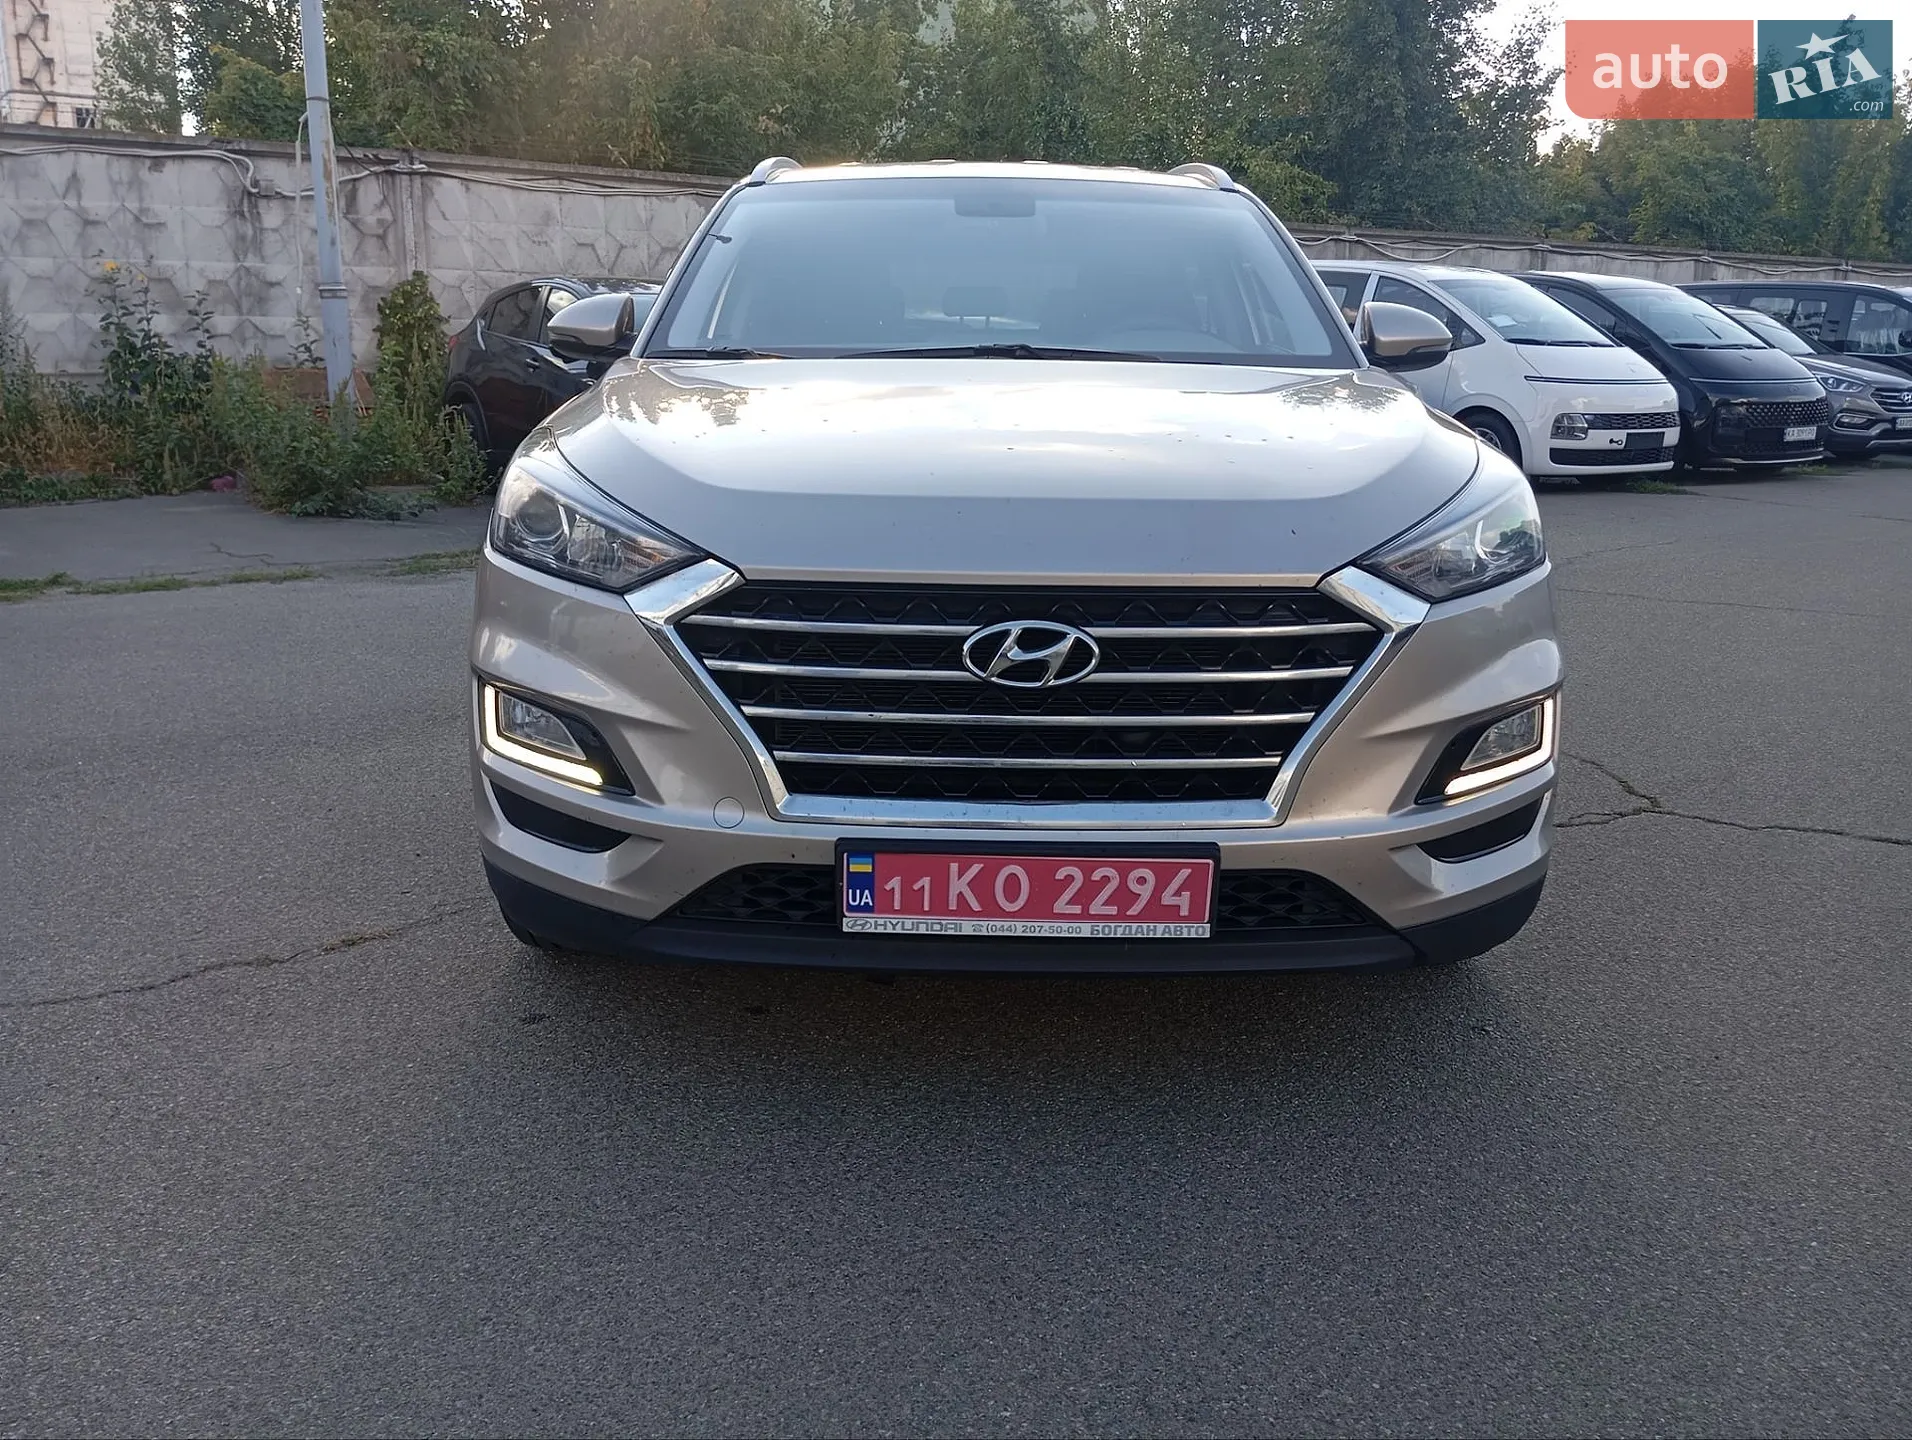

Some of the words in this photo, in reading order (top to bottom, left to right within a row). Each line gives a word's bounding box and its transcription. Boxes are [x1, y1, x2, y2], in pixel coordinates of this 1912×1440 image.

[848, 889, 873, 906] UA
[884, 876, 931, 911] 11
[948, 863, 1030, 912] KO
[1053, 866, 1193, 916] 2294
[873, 920, 963, 933] HYUNDAI
[986, 923, 1017, 934] (044)
[1021, 924, 1082, 935] 207-50-00
[1090, 924, 1158, 937] БОГДАН
[1161, 925, 1207, 937] АВТО
